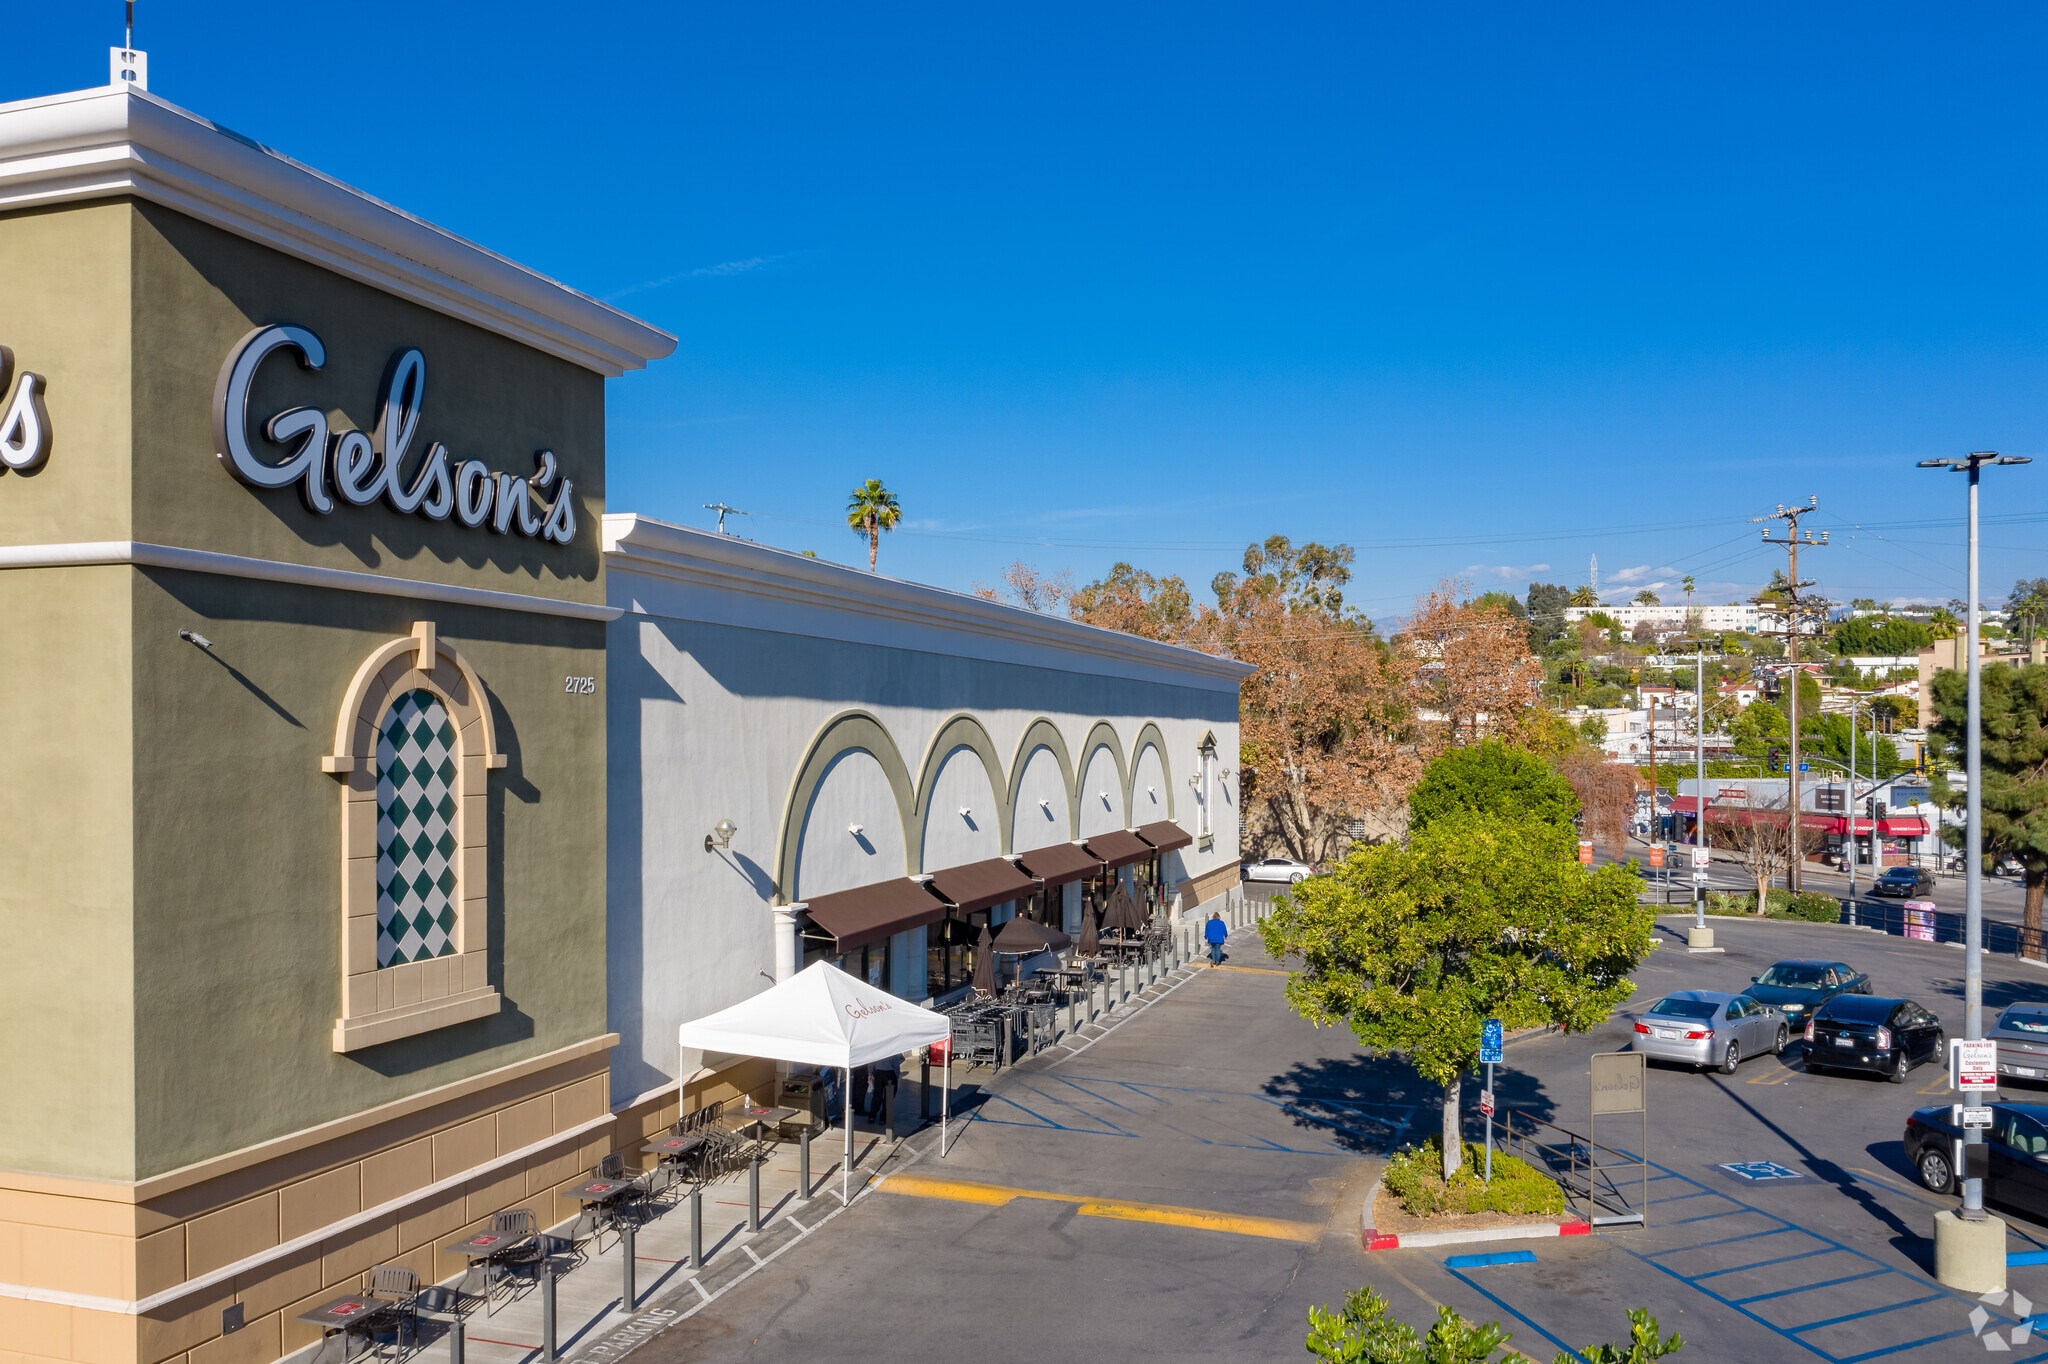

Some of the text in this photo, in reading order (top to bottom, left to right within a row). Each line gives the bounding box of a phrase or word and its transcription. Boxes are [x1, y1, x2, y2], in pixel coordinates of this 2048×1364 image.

[212, 323, 577, 545] Gelson's
[565, 676, 595, 694] 2725
[845, 998, 892, 1019] Gelson's
[1963, 1048, 1992, 1060] Gelson's
[589, 1308, 677, 1356] PARKING
